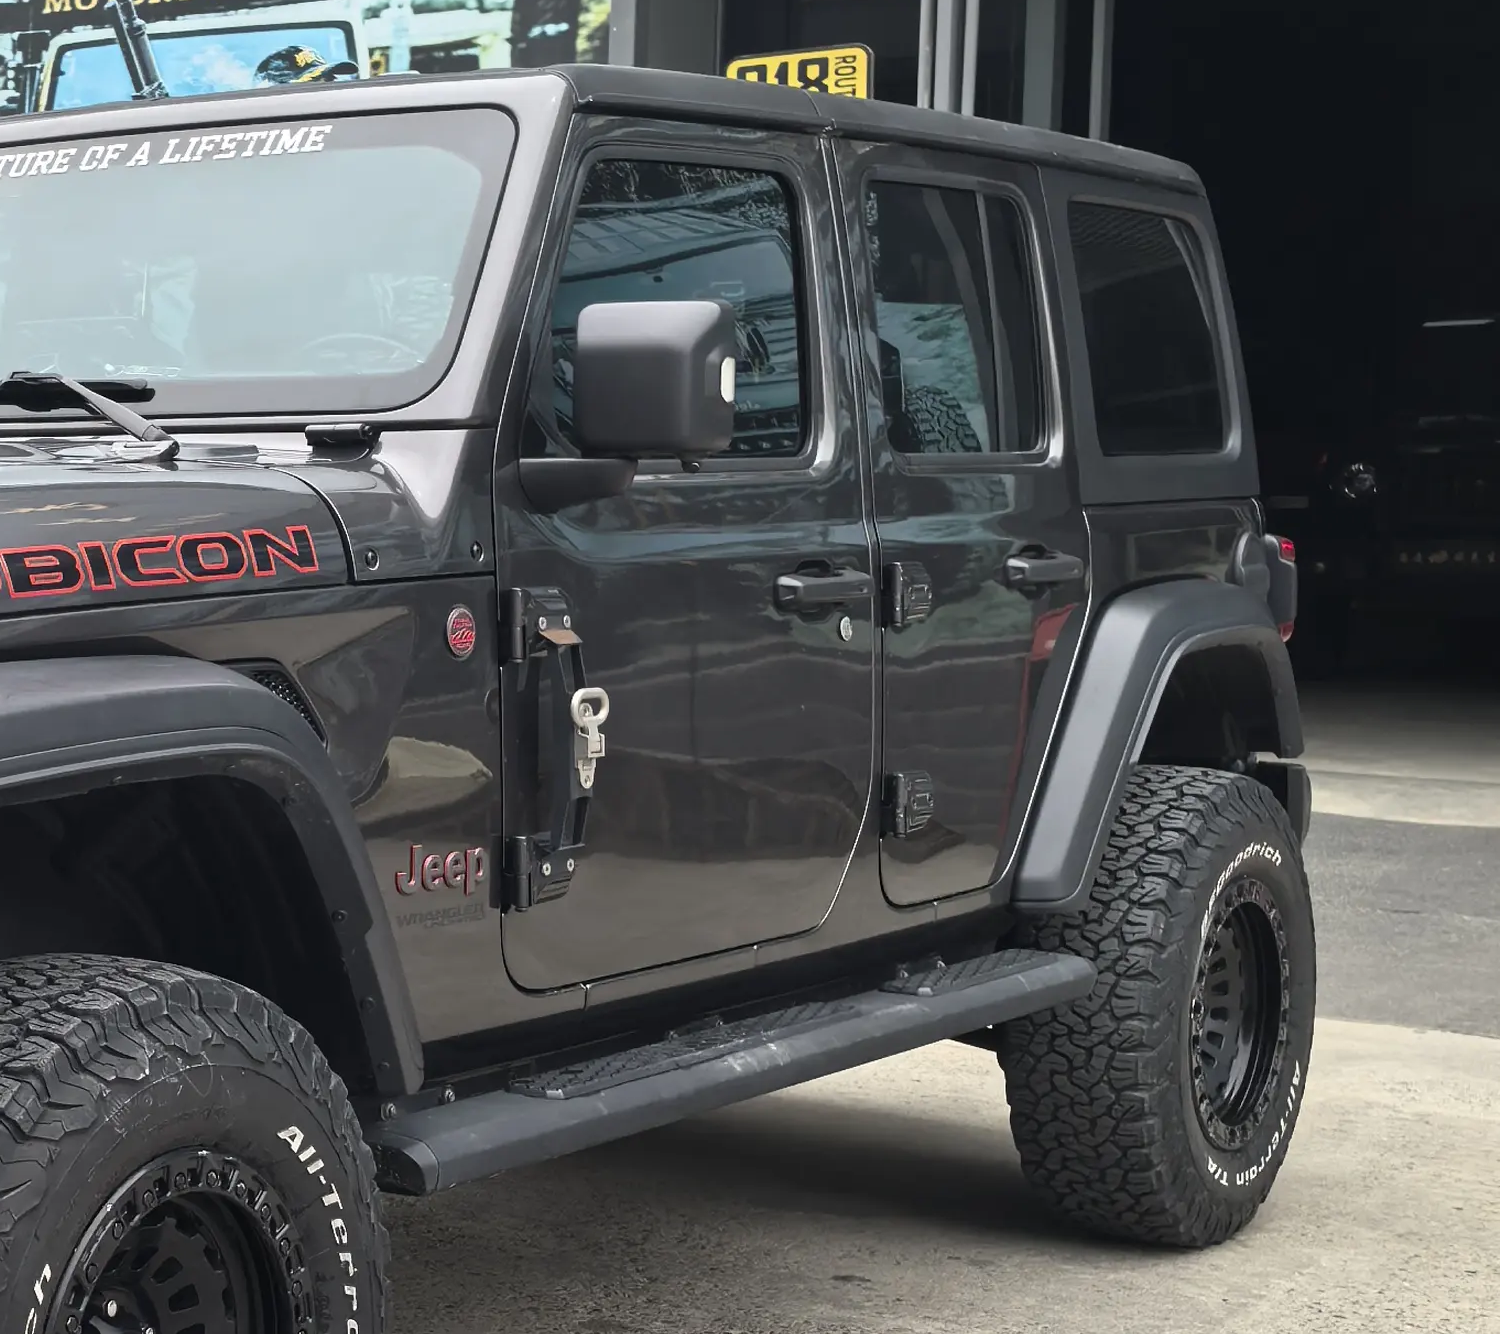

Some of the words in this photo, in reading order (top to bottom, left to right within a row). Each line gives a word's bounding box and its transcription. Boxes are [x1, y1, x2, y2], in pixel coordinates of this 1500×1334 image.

[79, 143, 129, 171] OF
[126, 141, 151, 167] A
[158, 125, 333, 165] LIFETIME
[395, 844, 491, 897] Jeep
